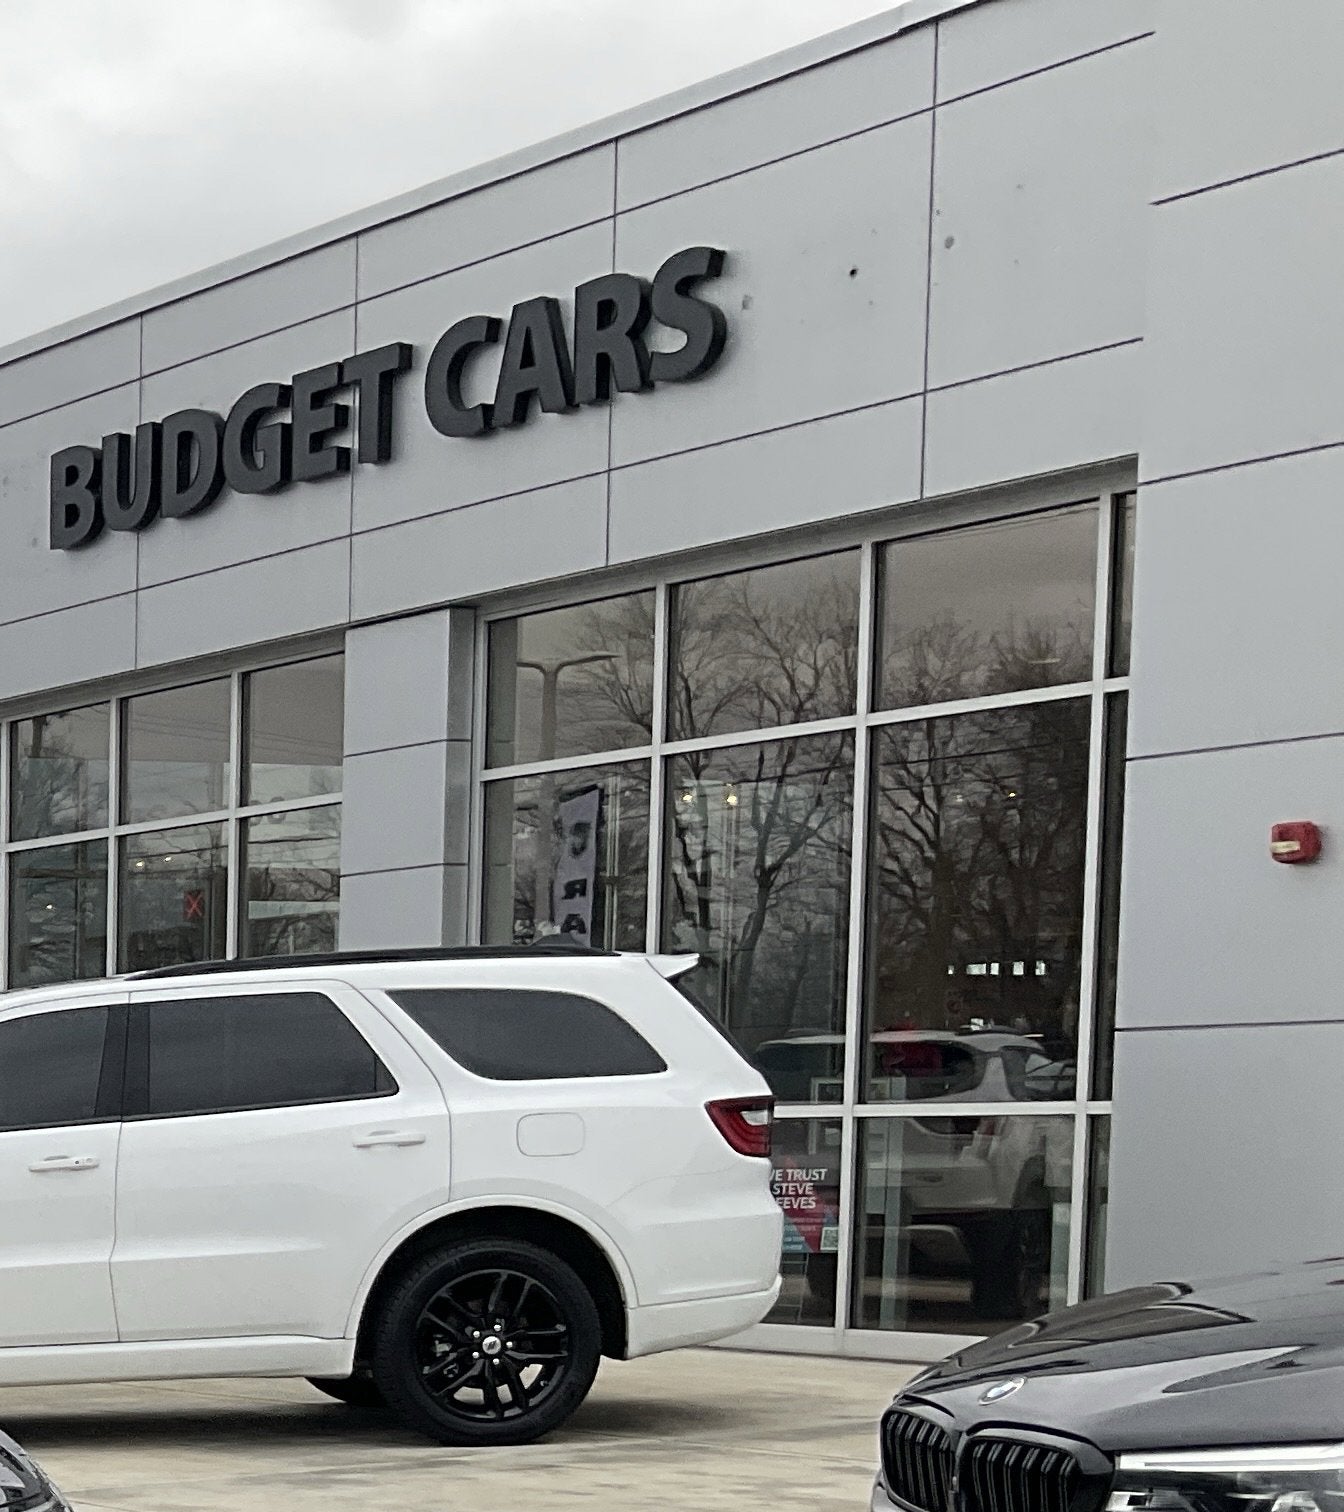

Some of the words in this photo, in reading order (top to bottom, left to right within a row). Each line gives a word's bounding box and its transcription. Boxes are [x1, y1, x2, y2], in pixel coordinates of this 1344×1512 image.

[50, 342, 413, 550] BUDGET
[424, 246, 728, 438] CARS
[786, 1168, 828, 1181] TRUST
[772, 1182, 814, 1195] STEVE
[775, 1196, 816, 1209] EEVES
